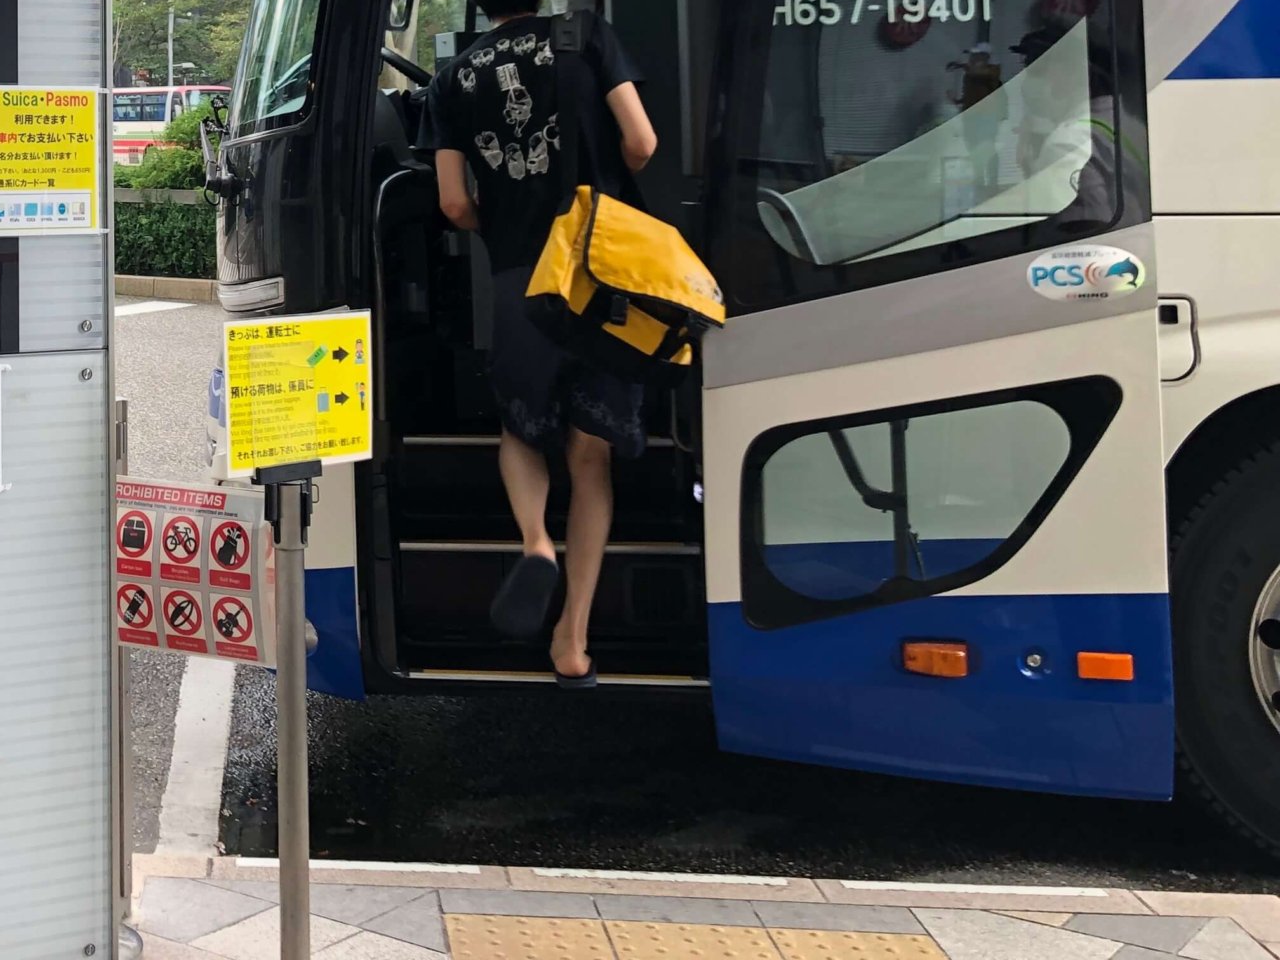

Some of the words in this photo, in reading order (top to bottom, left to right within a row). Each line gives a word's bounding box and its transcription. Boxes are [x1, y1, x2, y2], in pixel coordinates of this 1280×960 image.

[1031, 265, 1084, 287] PCS
[116, 484, 180, 502] ROHIBITED
[184, 492, 222, 506] ITEMS
